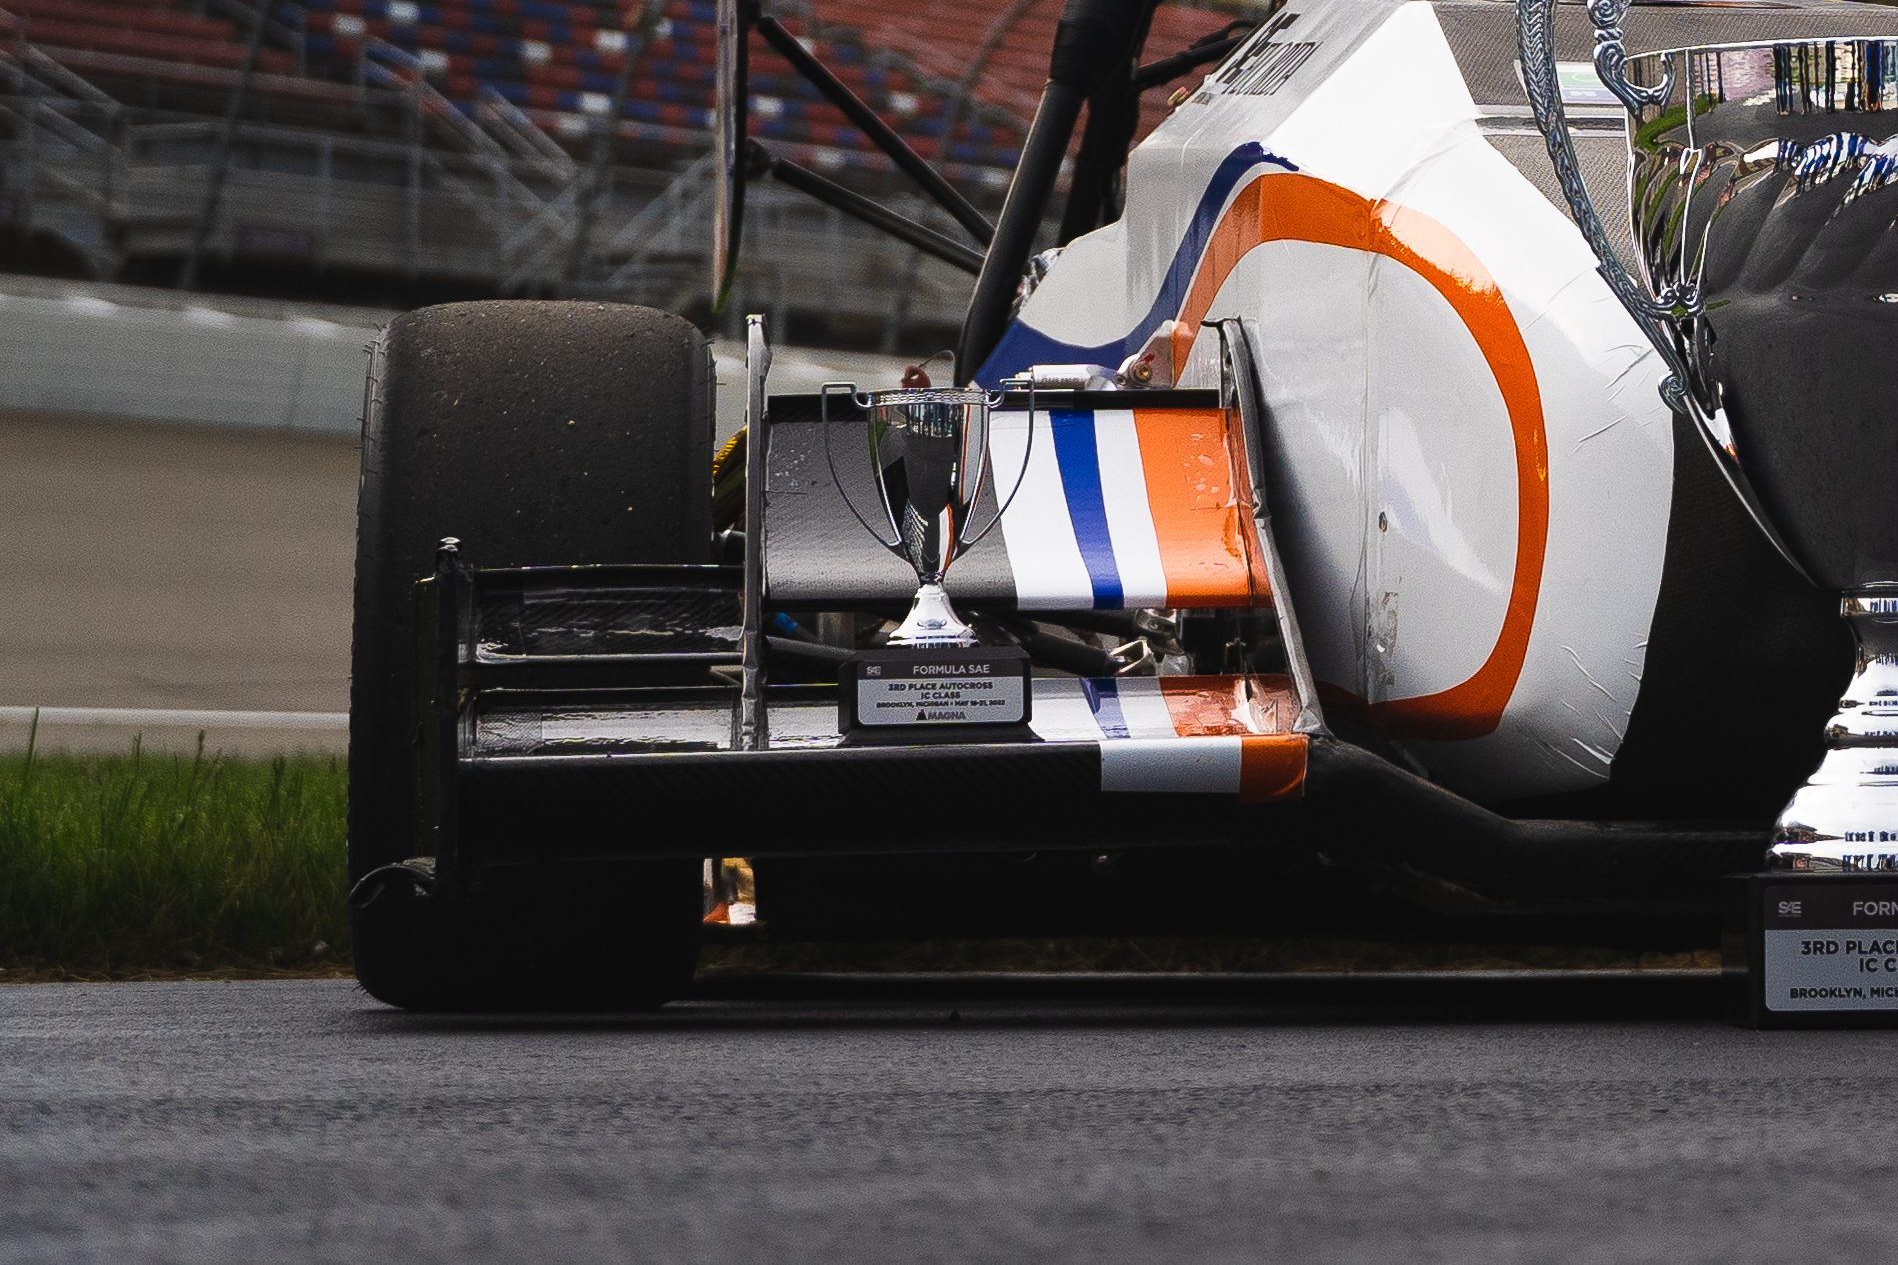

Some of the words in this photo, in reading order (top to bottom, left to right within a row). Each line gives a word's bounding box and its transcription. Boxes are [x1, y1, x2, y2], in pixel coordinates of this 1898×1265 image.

[1221, 40, 1324, 96] FLORIDA
[913, 665, 966, 675] FORMULA
[968, 664, 991, 674] SAE
[888, 683, 906, 692] 3RD
[908, 682, 937, 691] PLACE
[939, 681, 994, 690] AUTOCROSS
[920, 692, 931, 700] IC
[932, 691, 961, 699] CLASS
[927, 711, 967, 720] MAGNA
[1801, 939, 1840, 955] 3RD
[1859, 957, 1879, 973] IC
[1789, 986, 1867, 1000] BROOKLYN,
